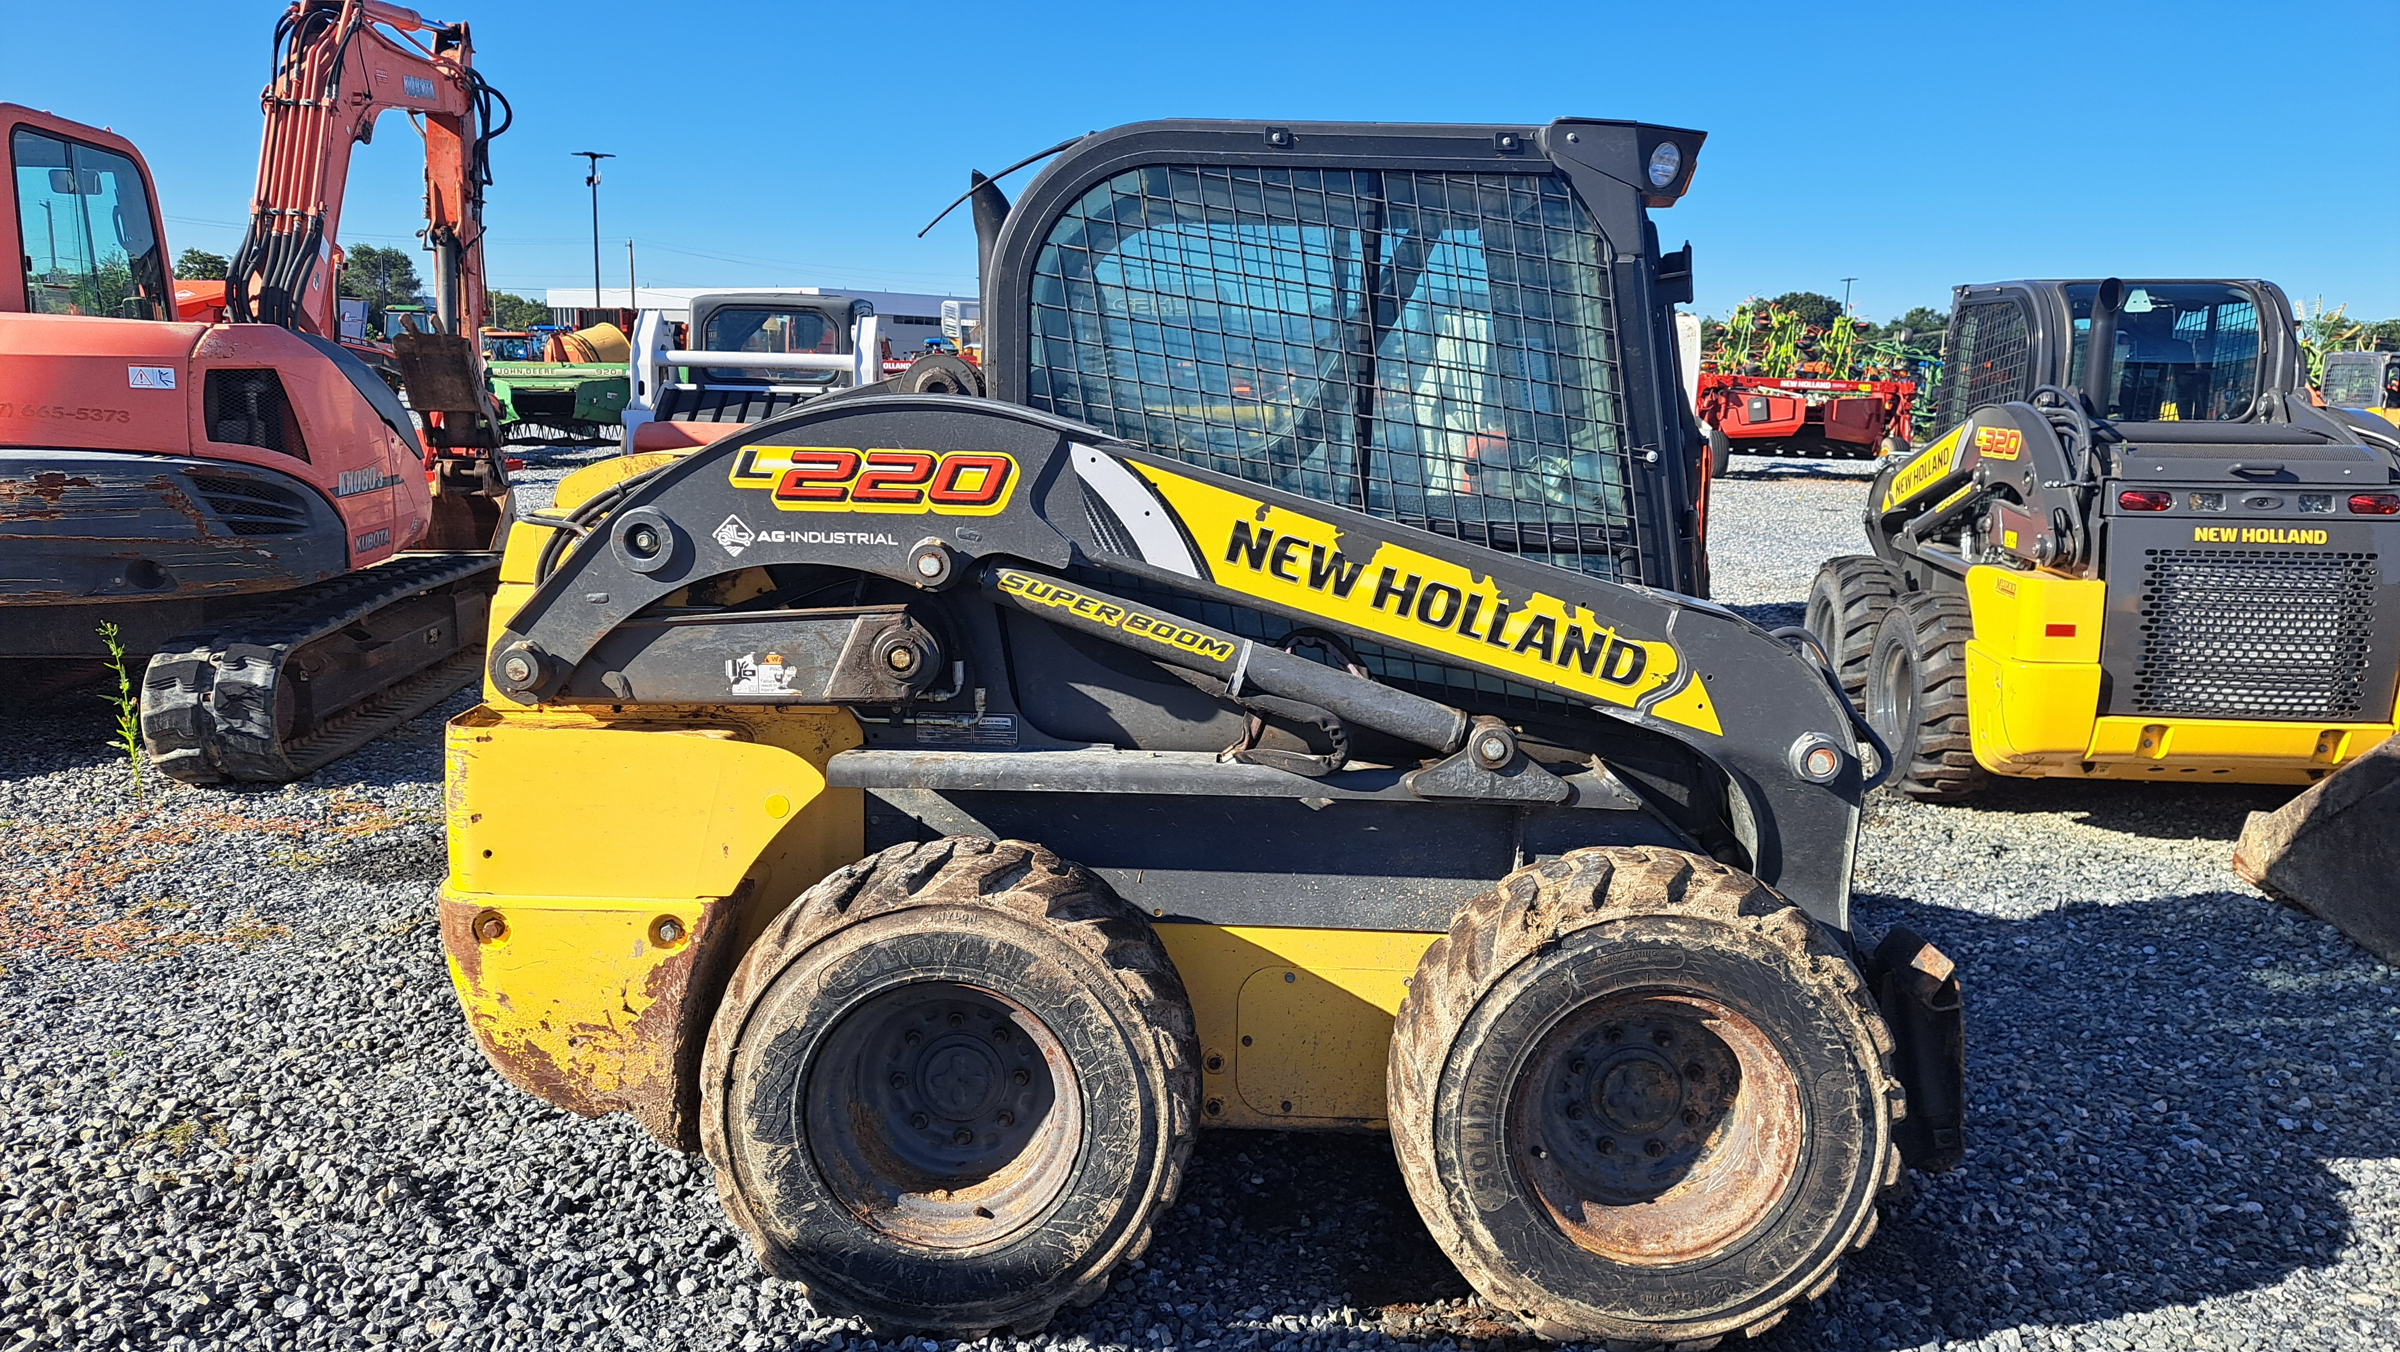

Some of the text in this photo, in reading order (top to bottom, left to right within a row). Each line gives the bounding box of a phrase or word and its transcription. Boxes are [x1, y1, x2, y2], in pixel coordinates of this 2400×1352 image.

[498, 367, 522, 376] JOHN
[525, 367, 556, 376] DEERE
[594, 367, 618, 376] 920
[883, 362, 911, 370] OLLAND
[1780, 380, 1798, 388] NEW
[1798, 381, 1831, 389] HOLLAND
[20, 404, 131, 424] 665-5373
[1976, 427, 2021, 458] L320
[731, 447, 1017, 510] L220
[1895, 476, 1912, 499] NEW
[1913, 446, 1950, 487] HOLLAND
[355, 527, 391, 555] KUBOTA
[756, 530, 900, 547] AG-INDUSTRIAL
[2193, 526, 2328, 545] NEW HOLLAND
[1223, 518, 1649, 688] NEW HOLLAND
[999, 573, 1235, 661] SUPER BOOM
[935, 910, 979, 924] NYLON
